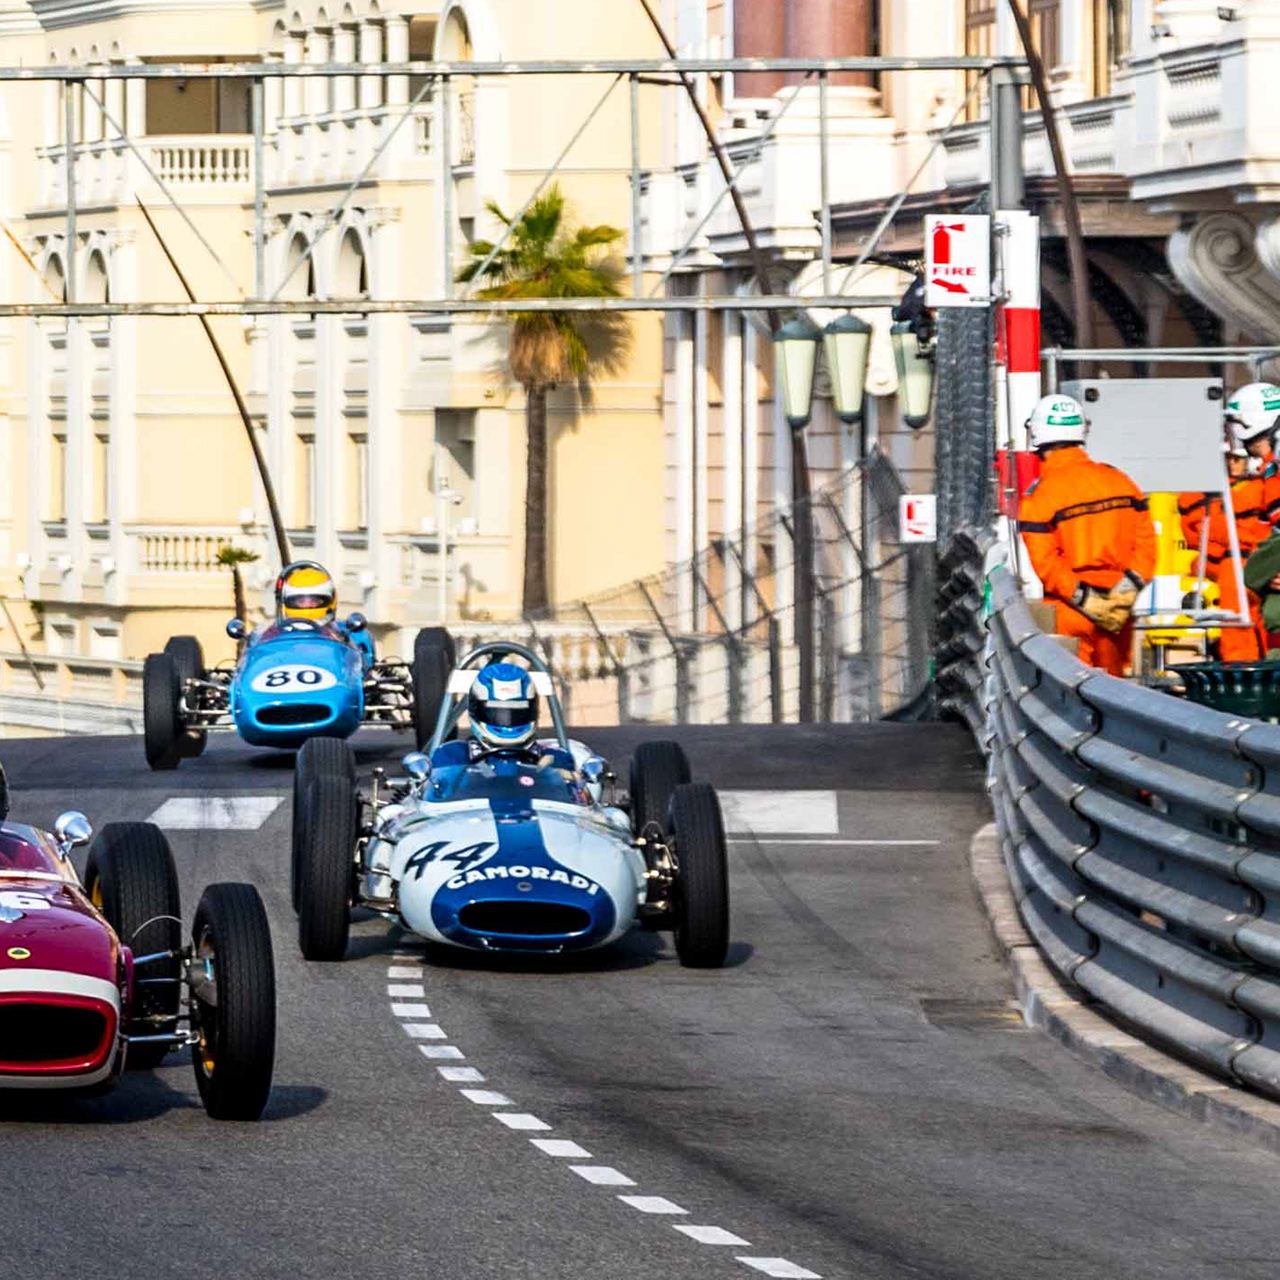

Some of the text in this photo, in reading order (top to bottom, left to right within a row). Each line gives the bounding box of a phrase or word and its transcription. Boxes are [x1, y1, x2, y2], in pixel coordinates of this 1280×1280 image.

[932, 266, 977, 276] FIRE
[265, 670, 323, 687] 80
[404, 841, 497, 880] 44
[446, 865, 600, 895] CAMORADI
